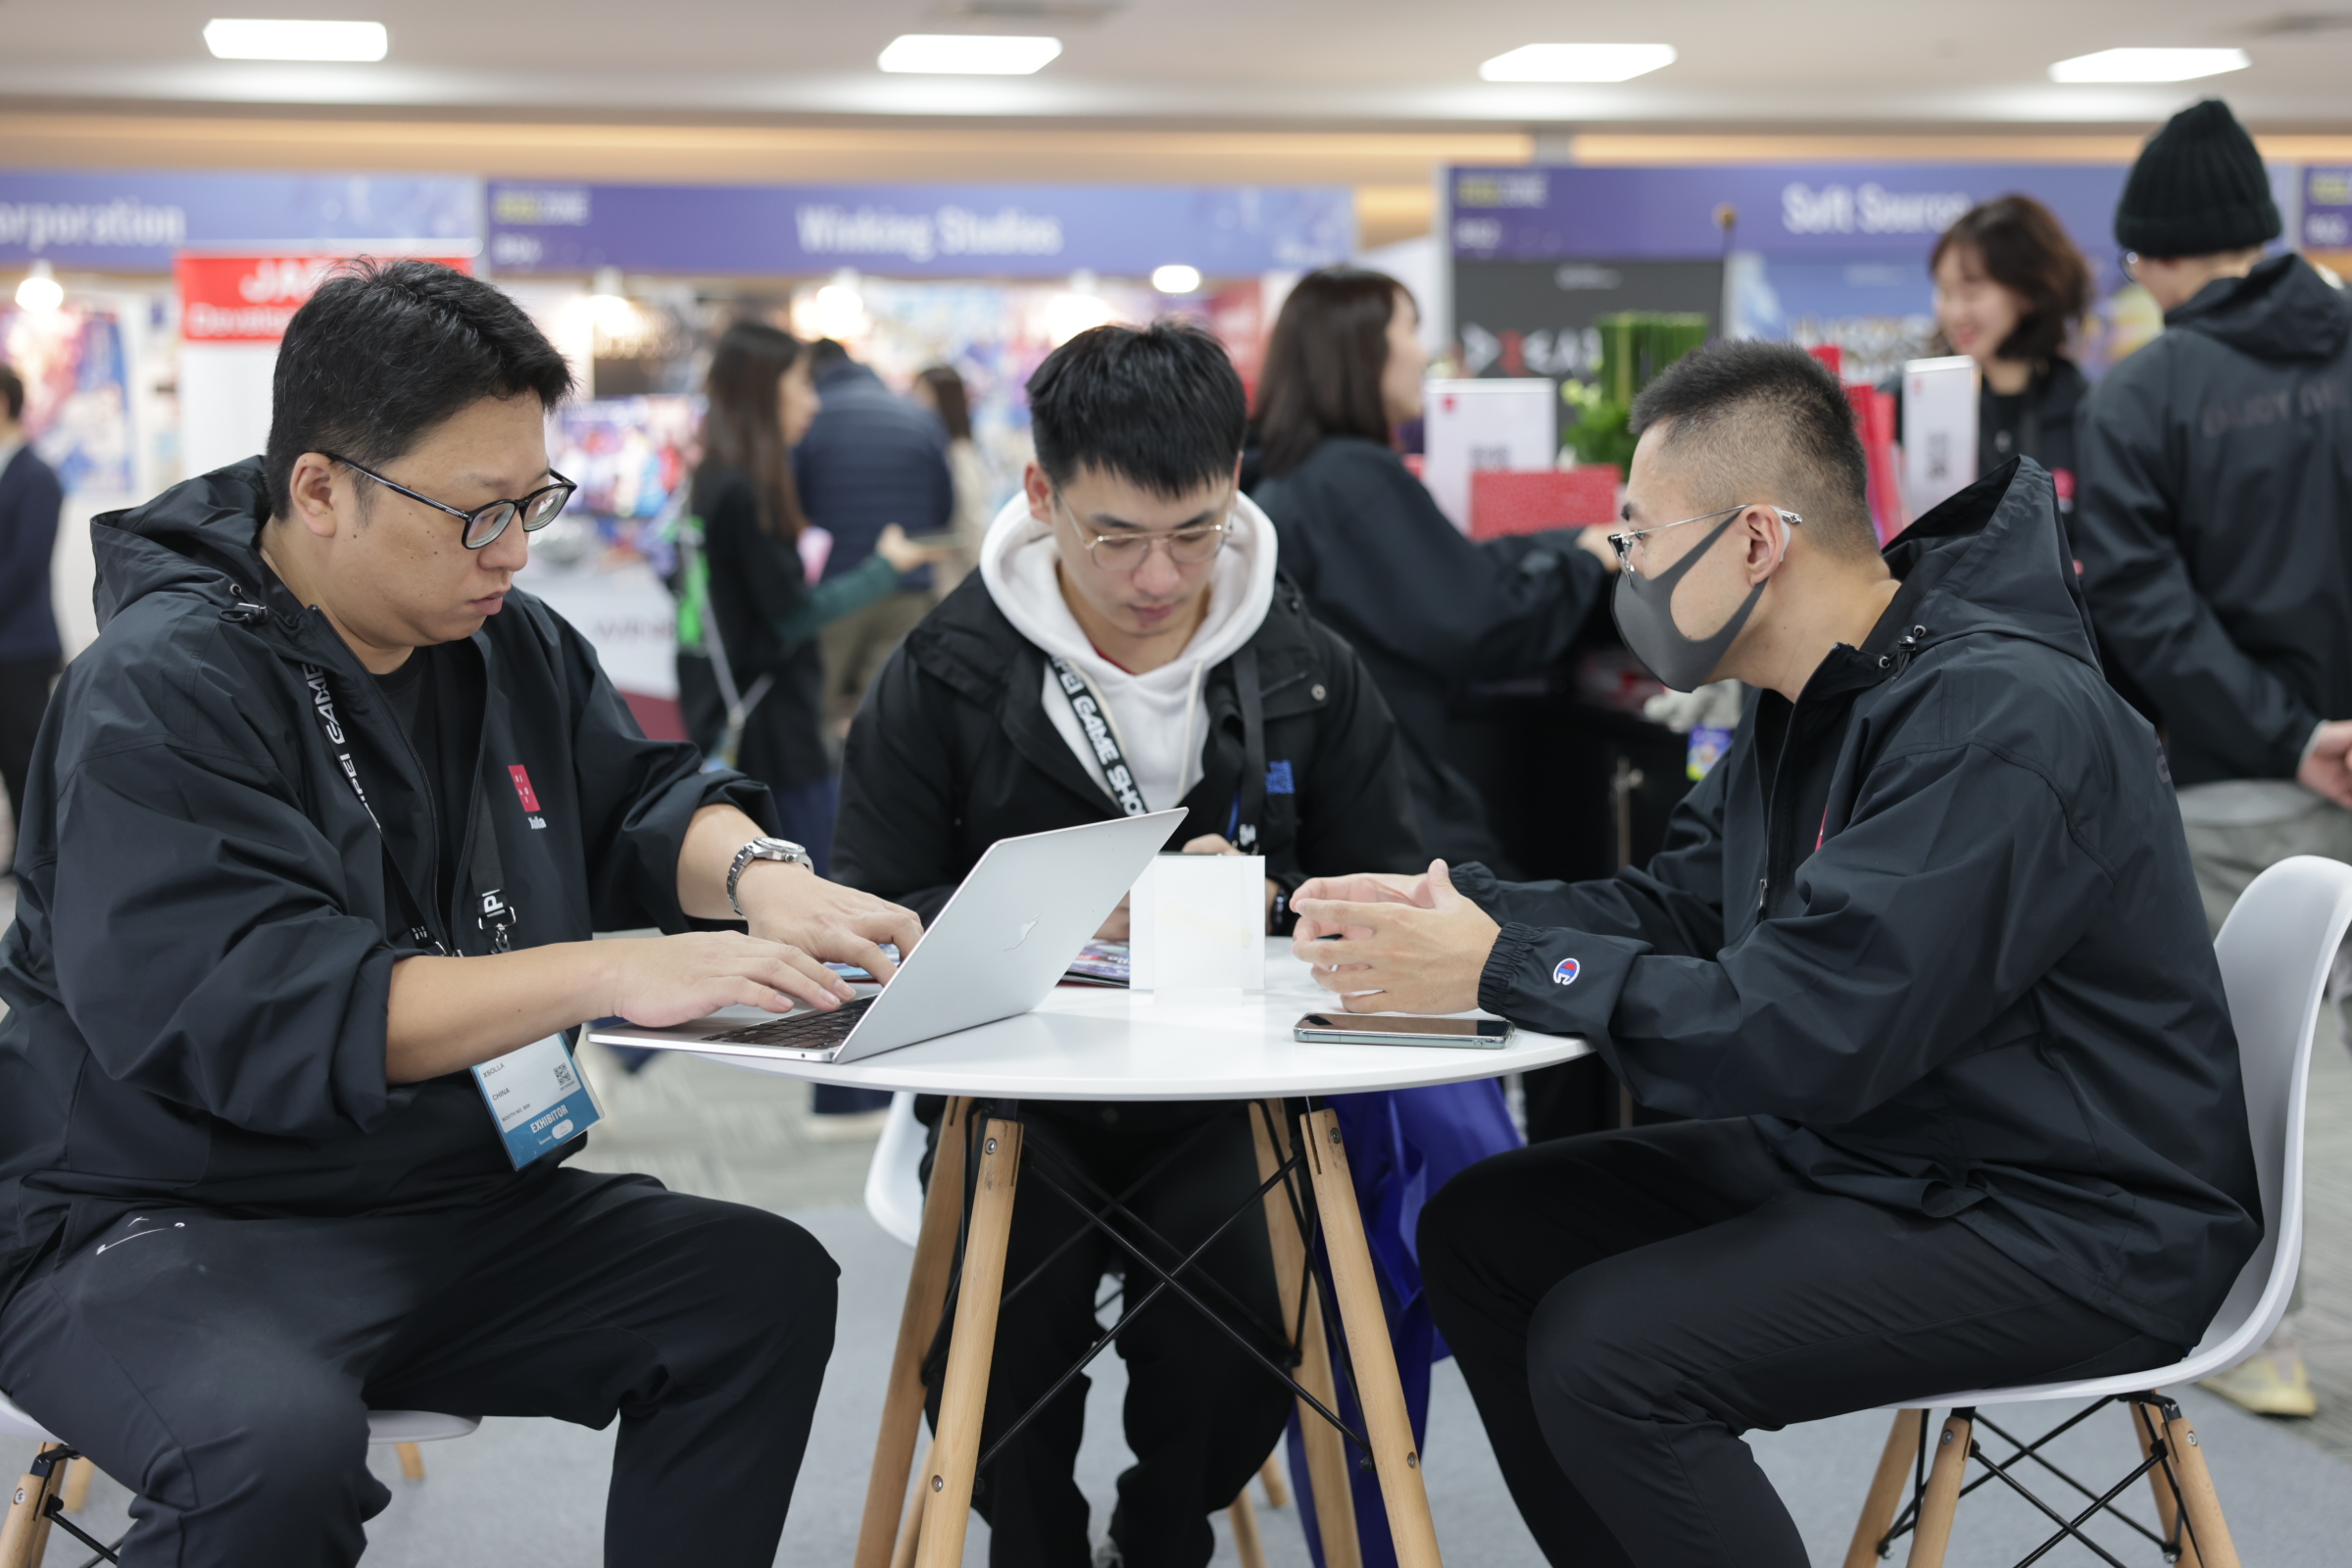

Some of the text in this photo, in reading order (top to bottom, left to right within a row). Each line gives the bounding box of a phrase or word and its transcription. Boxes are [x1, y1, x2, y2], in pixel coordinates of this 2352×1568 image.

[1072, 695, 1119, 765] GAME
[1106, 764, 1149, 816] SHO
[483, 1063, 505, 1078] XSOLLA
[493, 1088, 510, 1101] CHINA
[531, 1104, 568, 1133] EXHIBITOR
